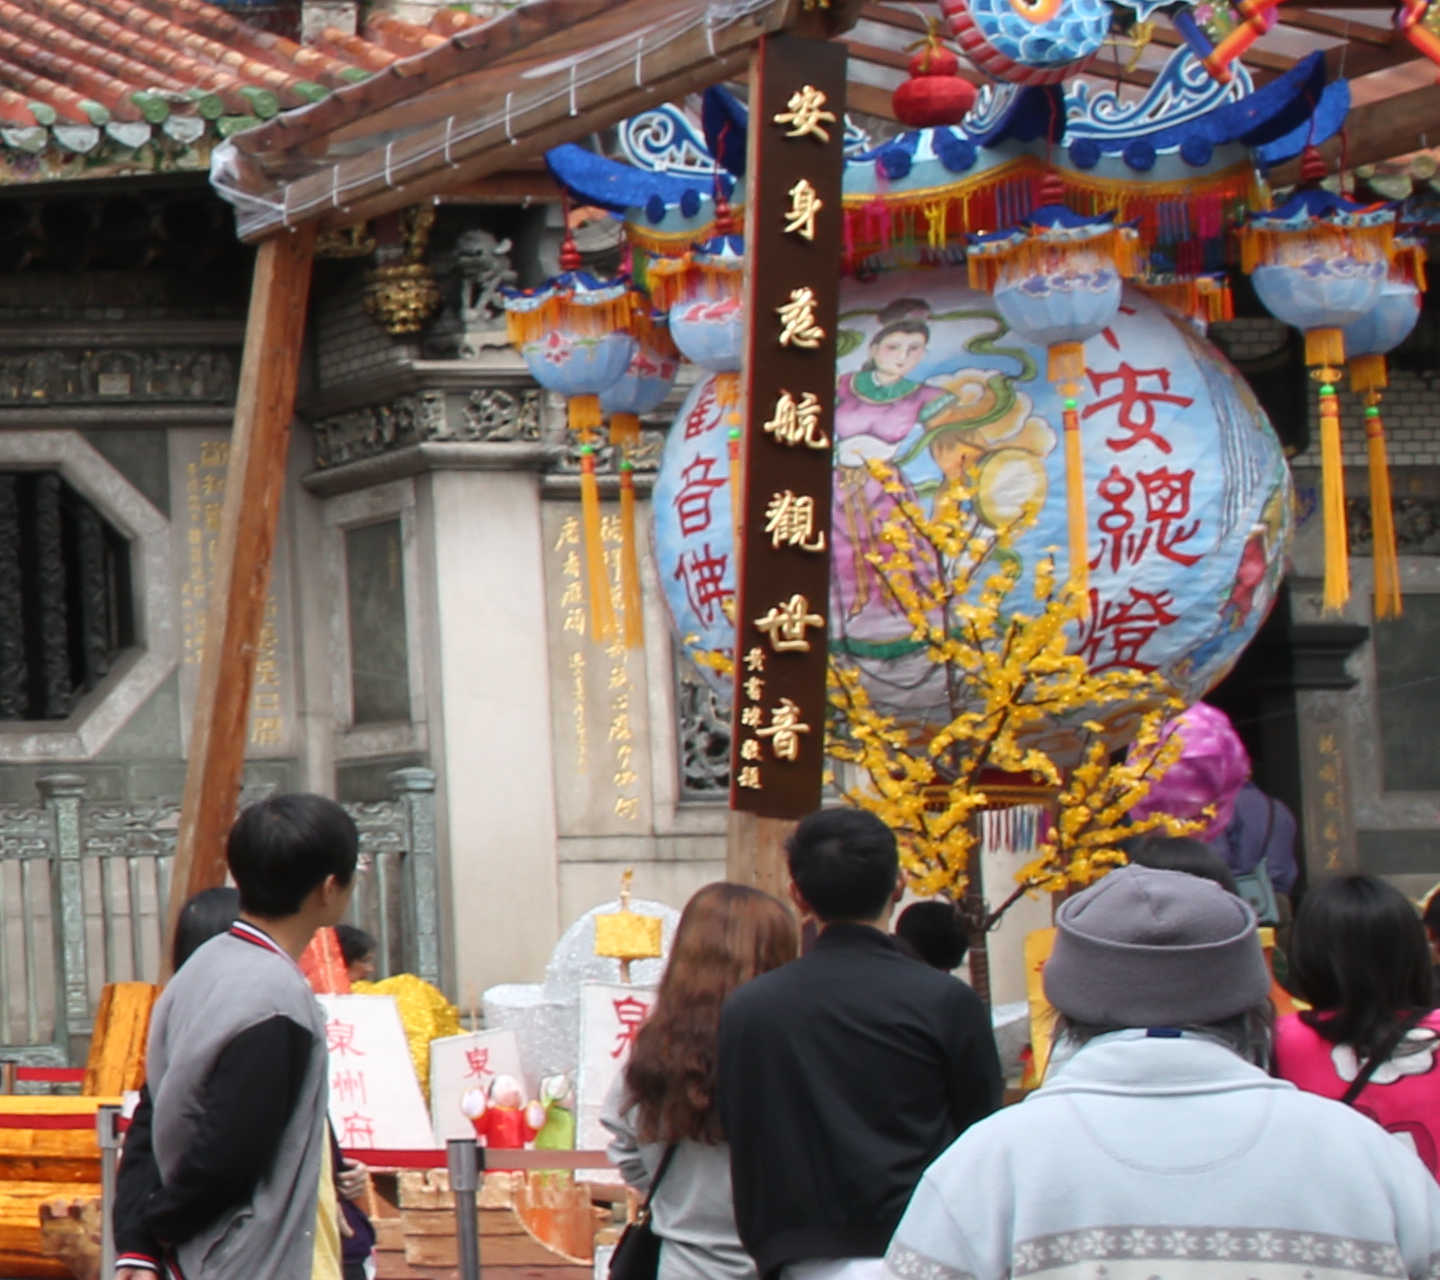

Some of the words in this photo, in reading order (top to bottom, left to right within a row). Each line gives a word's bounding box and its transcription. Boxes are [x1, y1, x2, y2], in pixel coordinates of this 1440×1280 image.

[754, 84, 836, 762] 安身慈航觀世音
[1074, 308, 1207, 677] 安總燈
